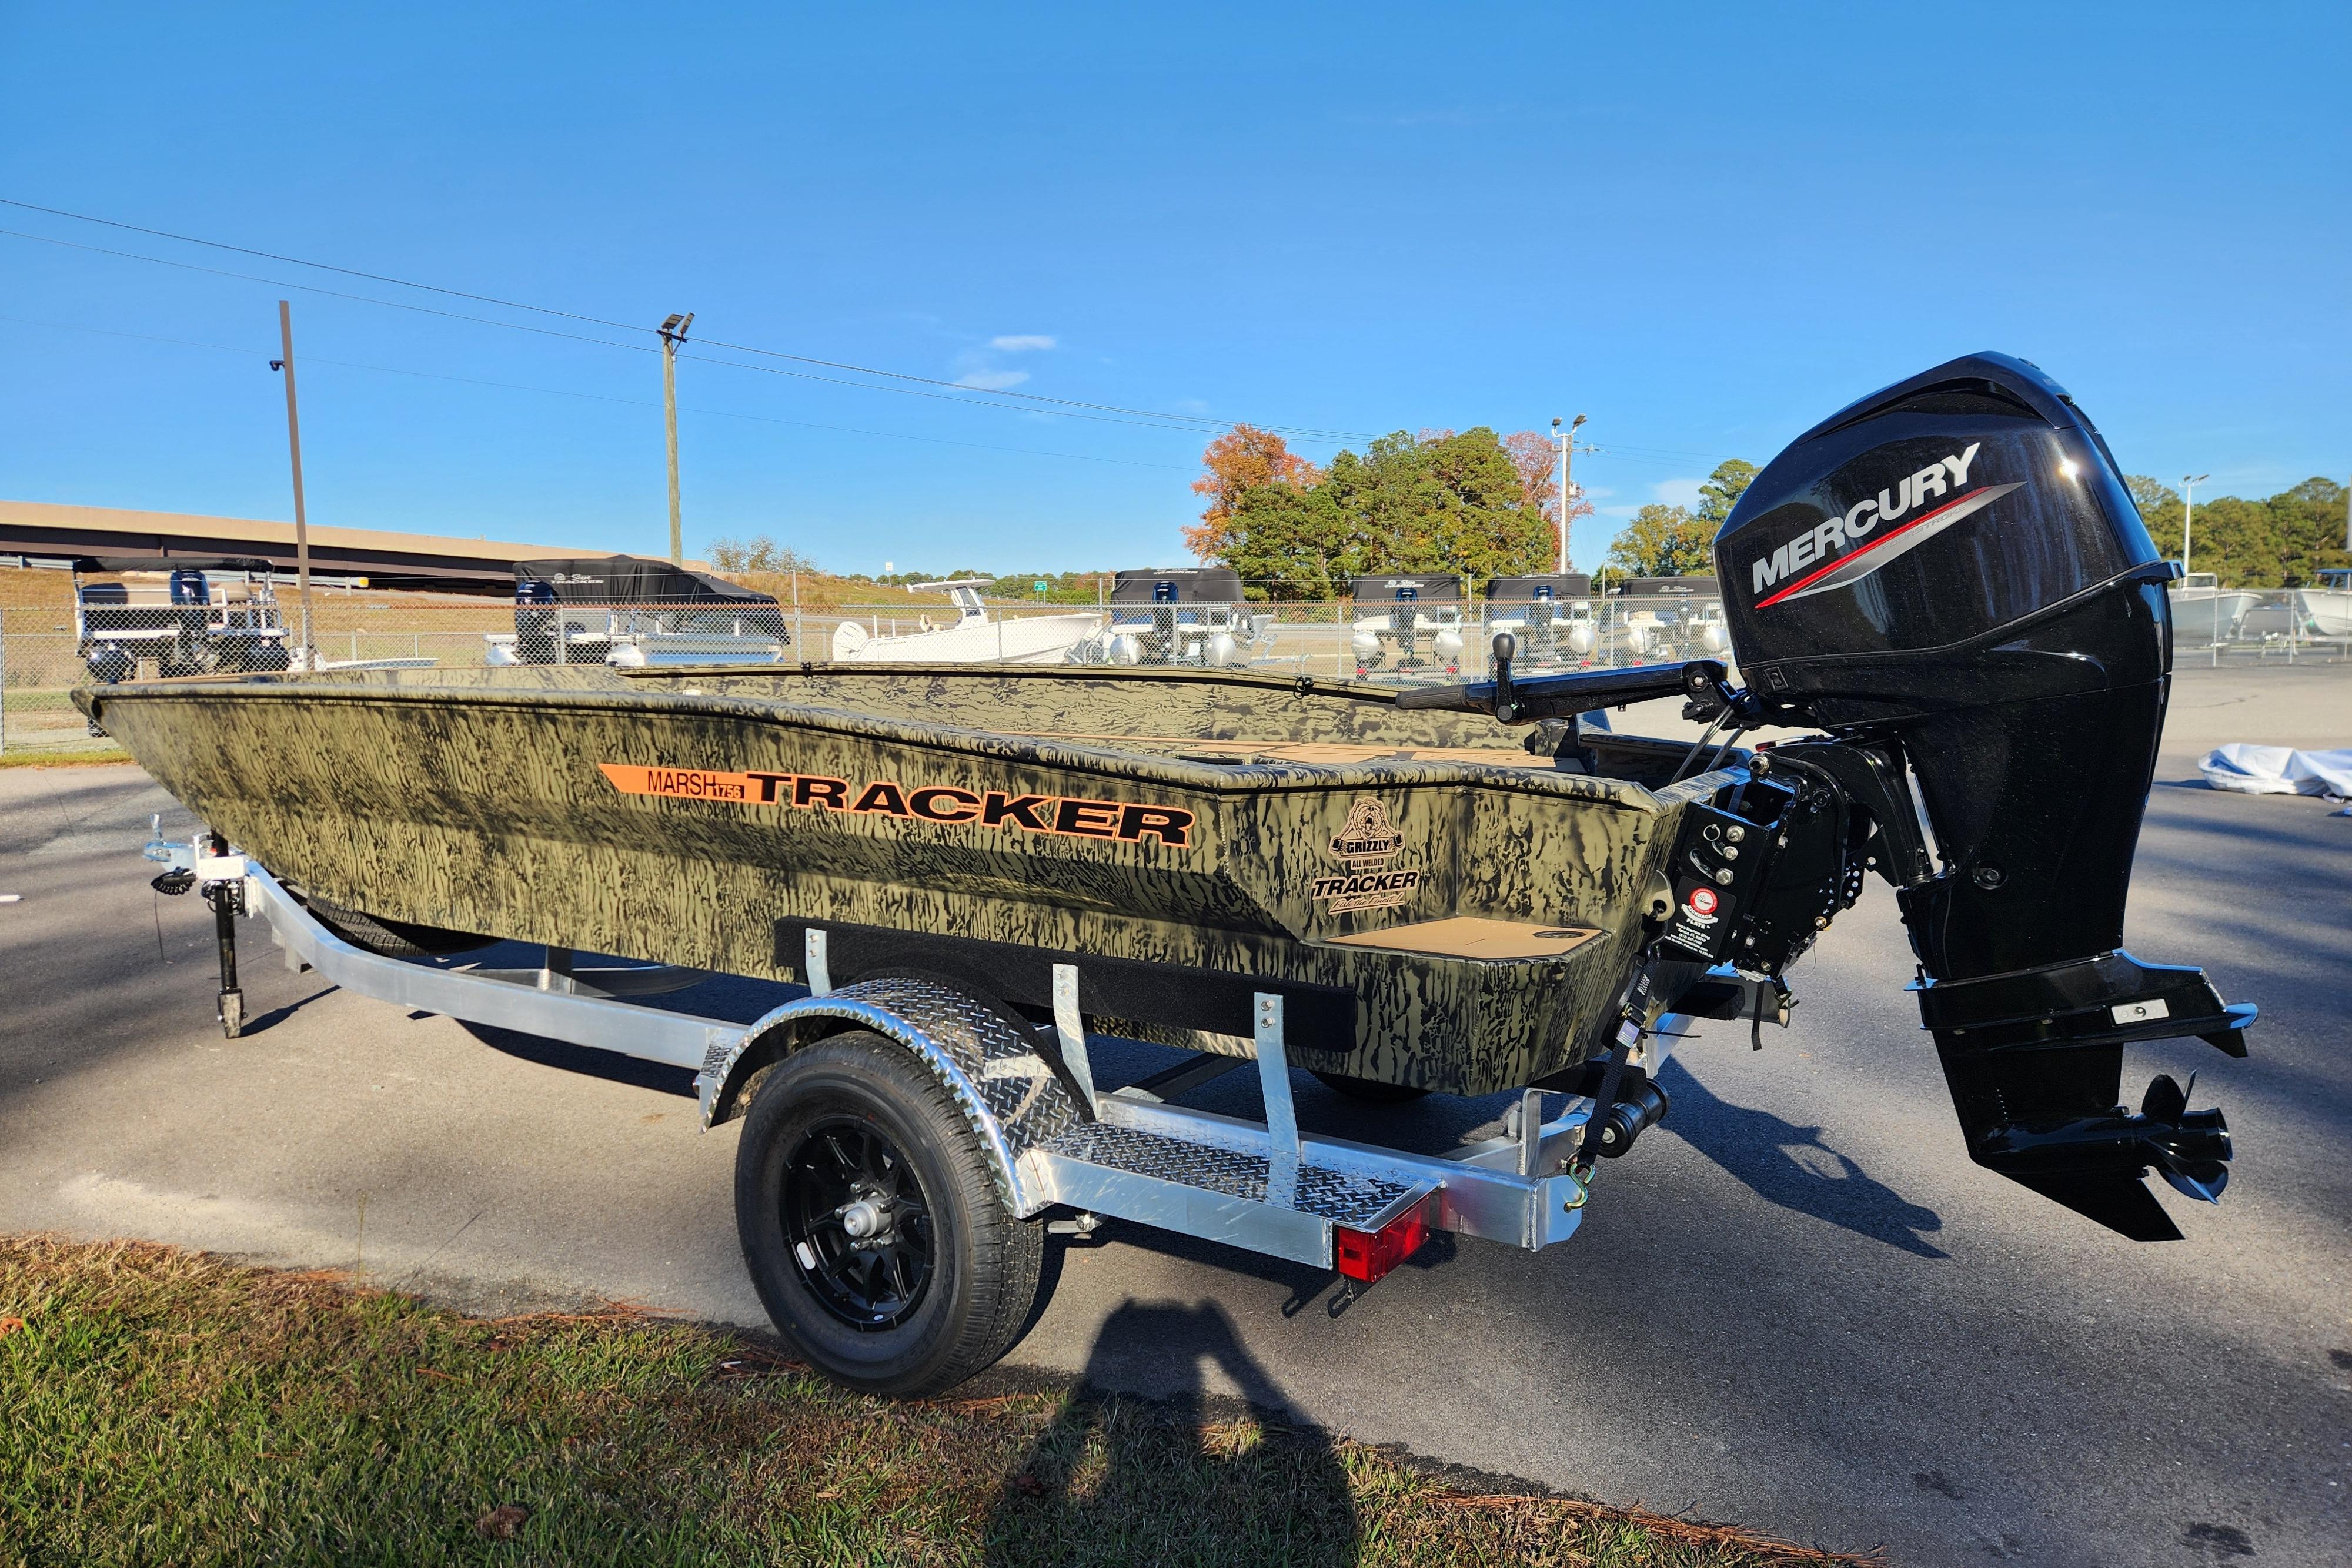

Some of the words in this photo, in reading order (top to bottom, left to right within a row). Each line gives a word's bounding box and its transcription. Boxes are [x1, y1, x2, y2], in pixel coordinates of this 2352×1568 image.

[1753, 442, 1980, 594] MERCURY
[1882, 503, 1966, 551] FOURSTROKE
[648, 770, 716, 796] MARSH
[714, 784, 741, 798] 1756
[746, 772, 1196, 845] TRACKER
[1347, 840, 1389, 854] GRIZZLY
[1352, 859, 1361, 868] ALL
[1363, 858, 1384, 867] WELDED
[1314, 872, 1418, 897] TRACKER
[1332, 900, 1352, 909] Fish
[1686, 918, 1705, 929] PLATE
